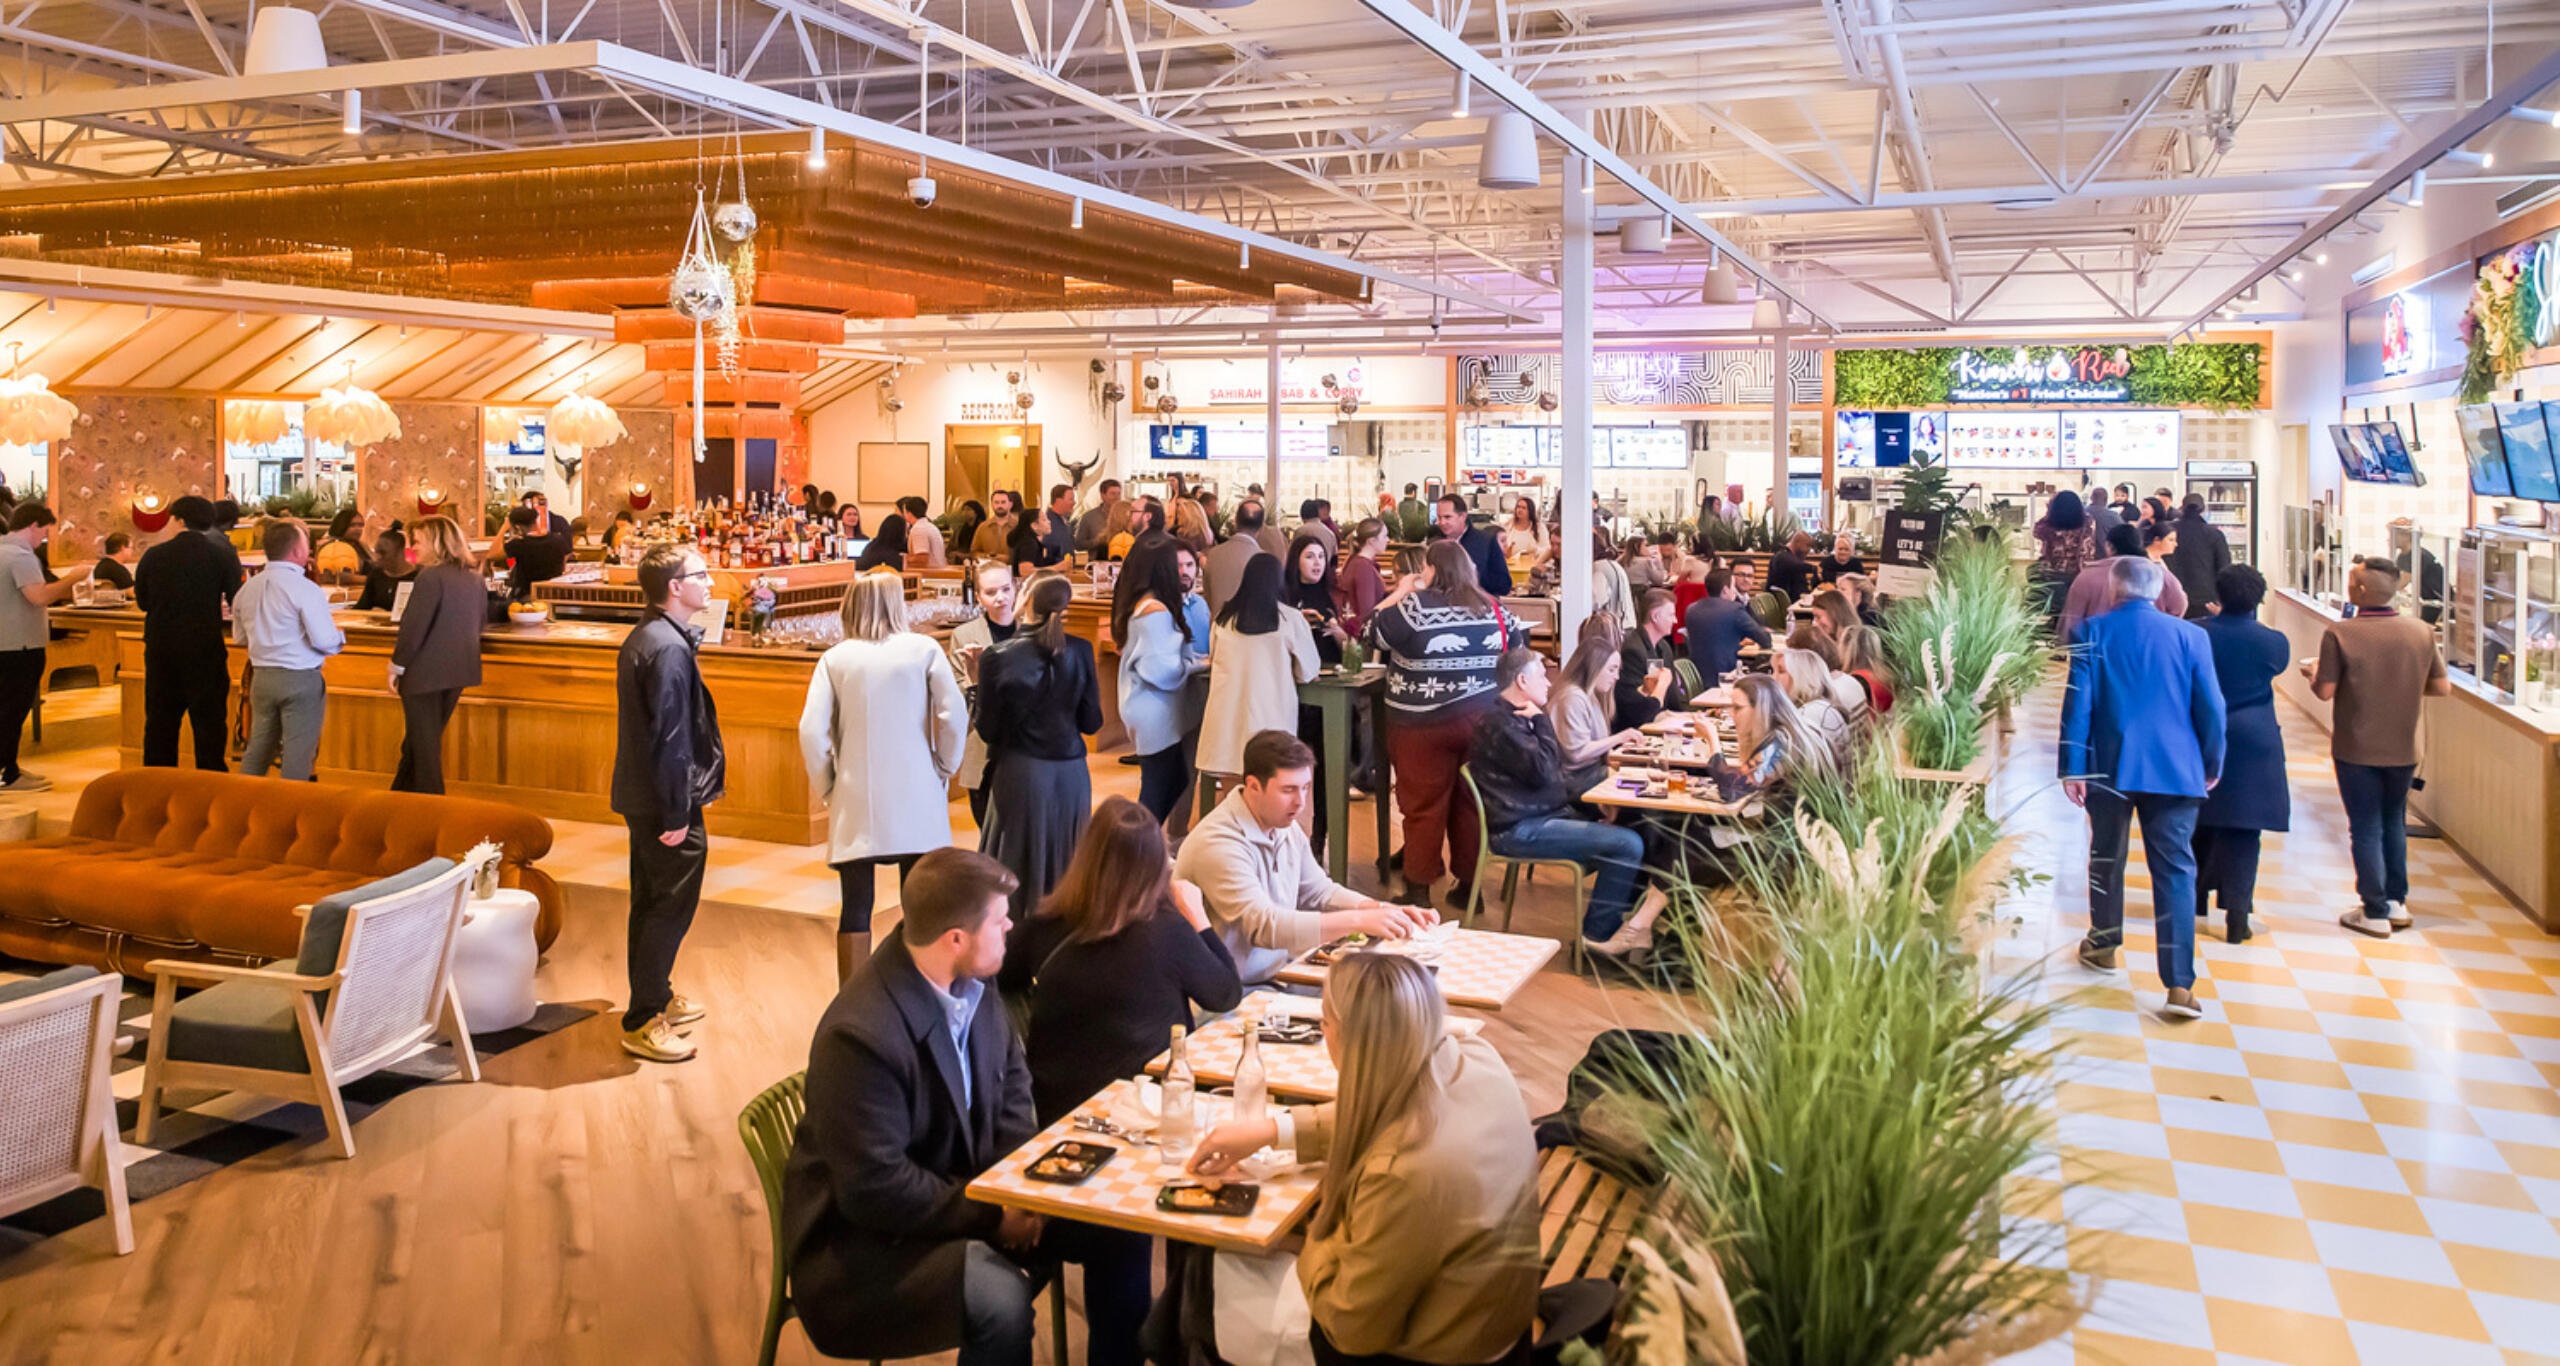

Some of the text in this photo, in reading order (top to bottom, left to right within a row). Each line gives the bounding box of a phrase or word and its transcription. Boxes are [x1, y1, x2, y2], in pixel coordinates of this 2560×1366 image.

[1951, 348, 2130, 383] Kimchi Red
[1209, 389, 1262, 400] SAHIRAH
[1309, 388, 1318, 398] &
[2031, 388, 2065, 399] Fried
